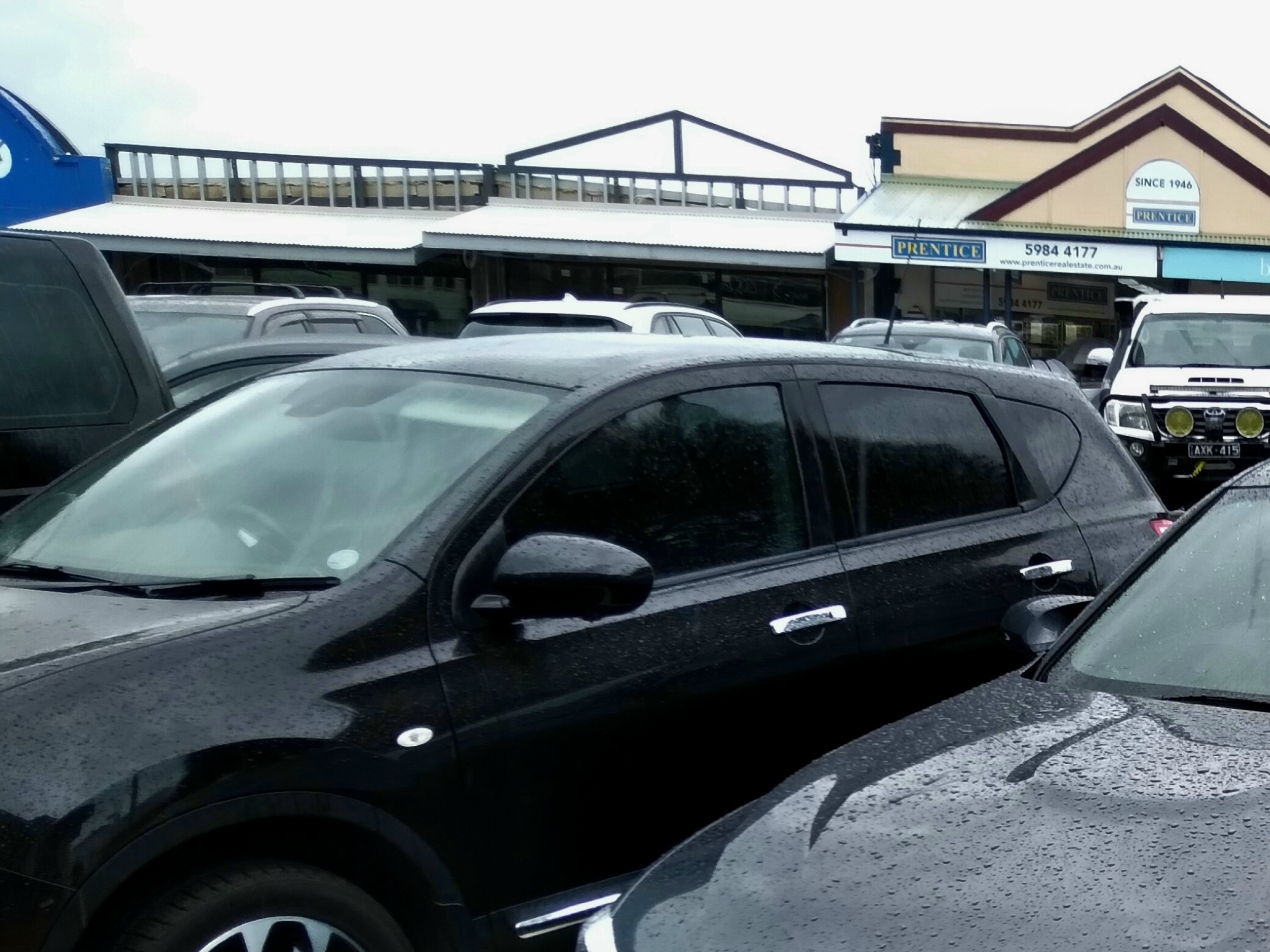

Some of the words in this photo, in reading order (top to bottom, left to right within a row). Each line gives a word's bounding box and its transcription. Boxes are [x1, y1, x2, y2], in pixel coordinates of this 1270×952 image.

[1135, 177, 1165, 188] SINCE
[1169, 178, 1193, 191] 1946
[1136, 209, 1192, 225] PRENTICE
[896, 239, 982, 259] PRENTICE
[1024, 242, 1060, 257] 5984
[1063, 244, 1098, 259] 4177
[999, 257, 1124, 272] www.prenticerealestate.com.au
[1052, 286, 1106, 302] PRENTICE
